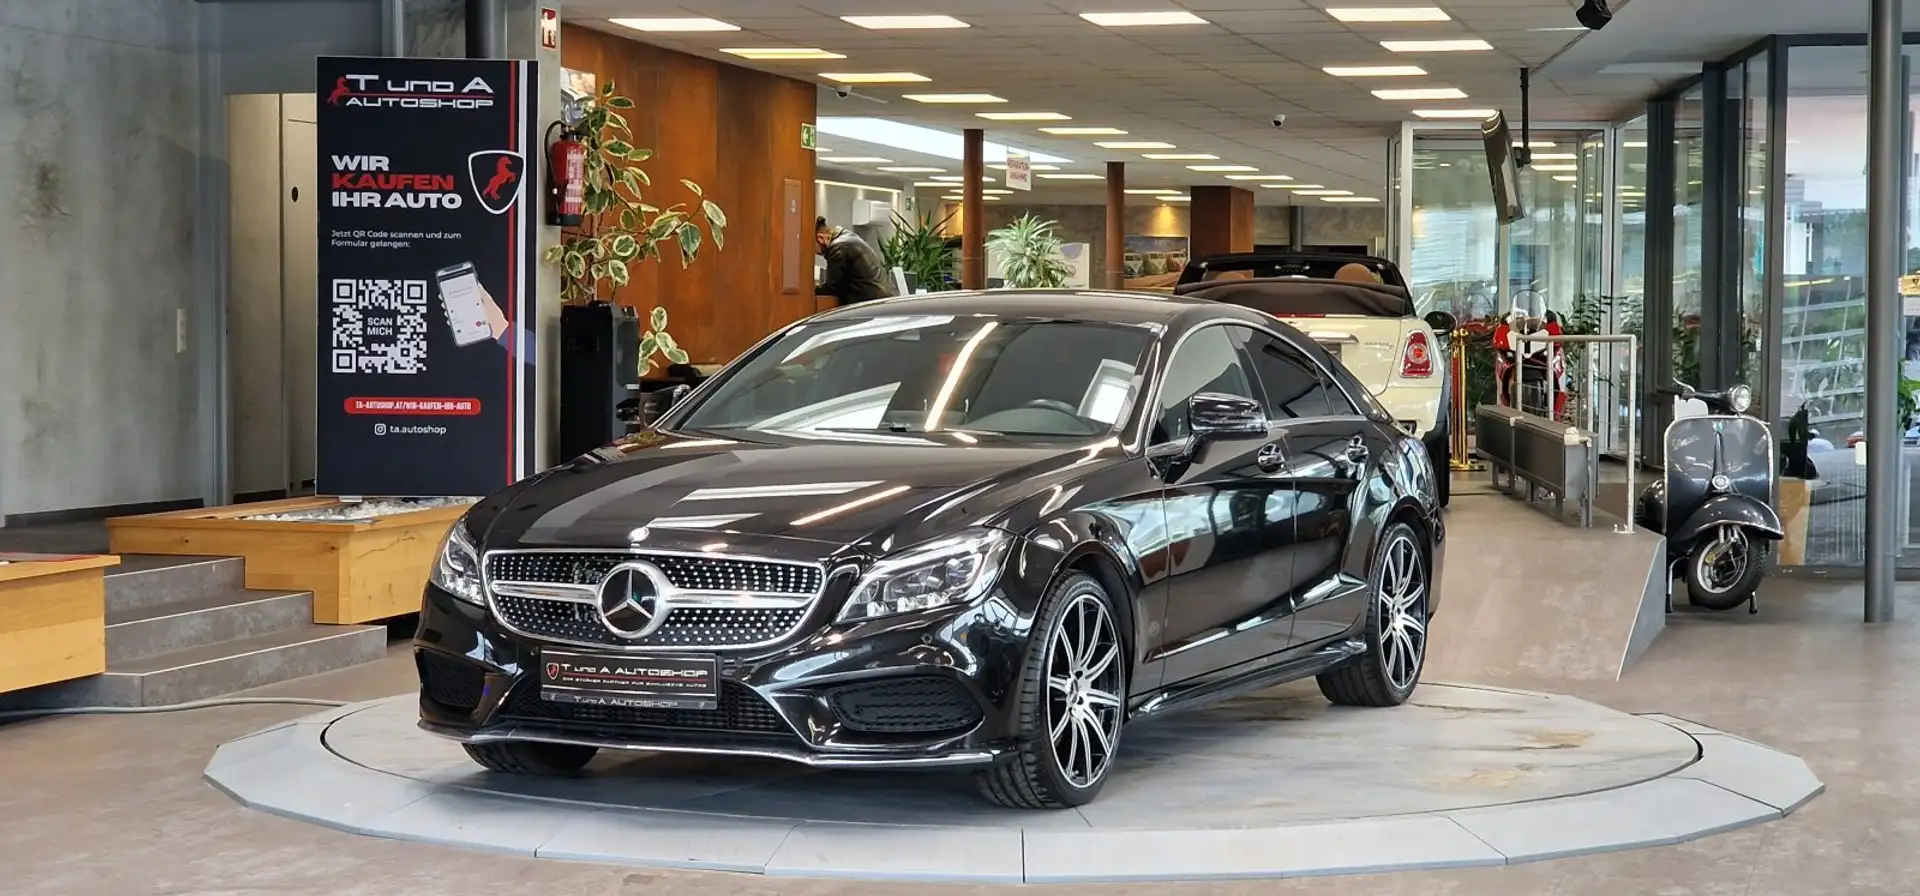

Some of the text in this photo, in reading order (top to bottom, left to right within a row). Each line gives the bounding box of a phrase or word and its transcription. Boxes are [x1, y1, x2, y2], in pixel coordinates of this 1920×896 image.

[346, 74, 379, 91] T
[462, 76, 494, 94] A
[346, 97, 494, 109] AUTOSHOP
[331, 154, 389, 172] WIR
[331, 173, 454, 191] KAUFEN
[331, 192, 463, 209] IHR AUTO
[331, 230, 462, 240] Jetzt QR Code scannen und zum
[331, 239, 410, 249] Formular gelangen:
[367, 317, 393, 326] SCAN
[367, 326, 393, 336] MICH
[390, 425, 447, 436] ta.autoshop
[614, 667, 708, 678] AUTOSHOP
[610, 698, 678, 709] AUTOSHOP
